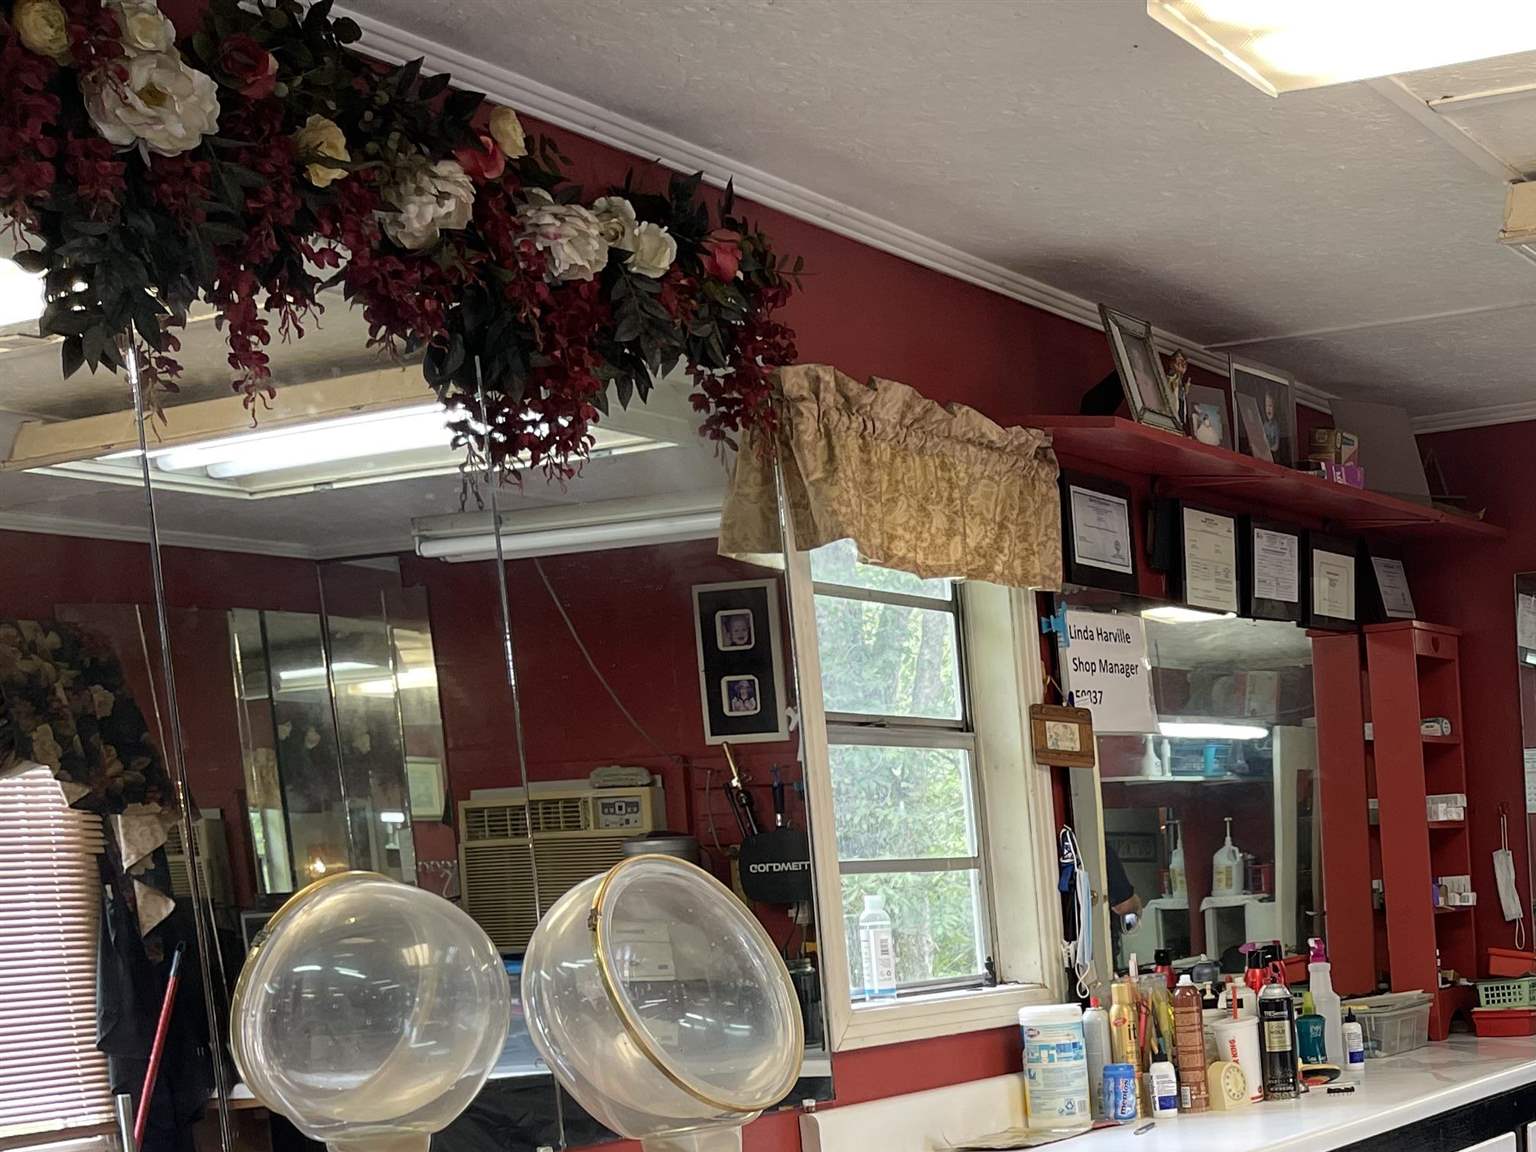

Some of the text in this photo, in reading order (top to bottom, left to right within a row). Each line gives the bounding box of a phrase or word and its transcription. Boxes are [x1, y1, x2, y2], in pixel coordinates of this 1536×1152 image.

[1069, 624, 1132, 644] Linda Harville
[1072, 657, 1139, 678] Shop Manager
[1128, 1023, 1137, 1041] it
[1120, 1080, 1129, 1115] mentos
